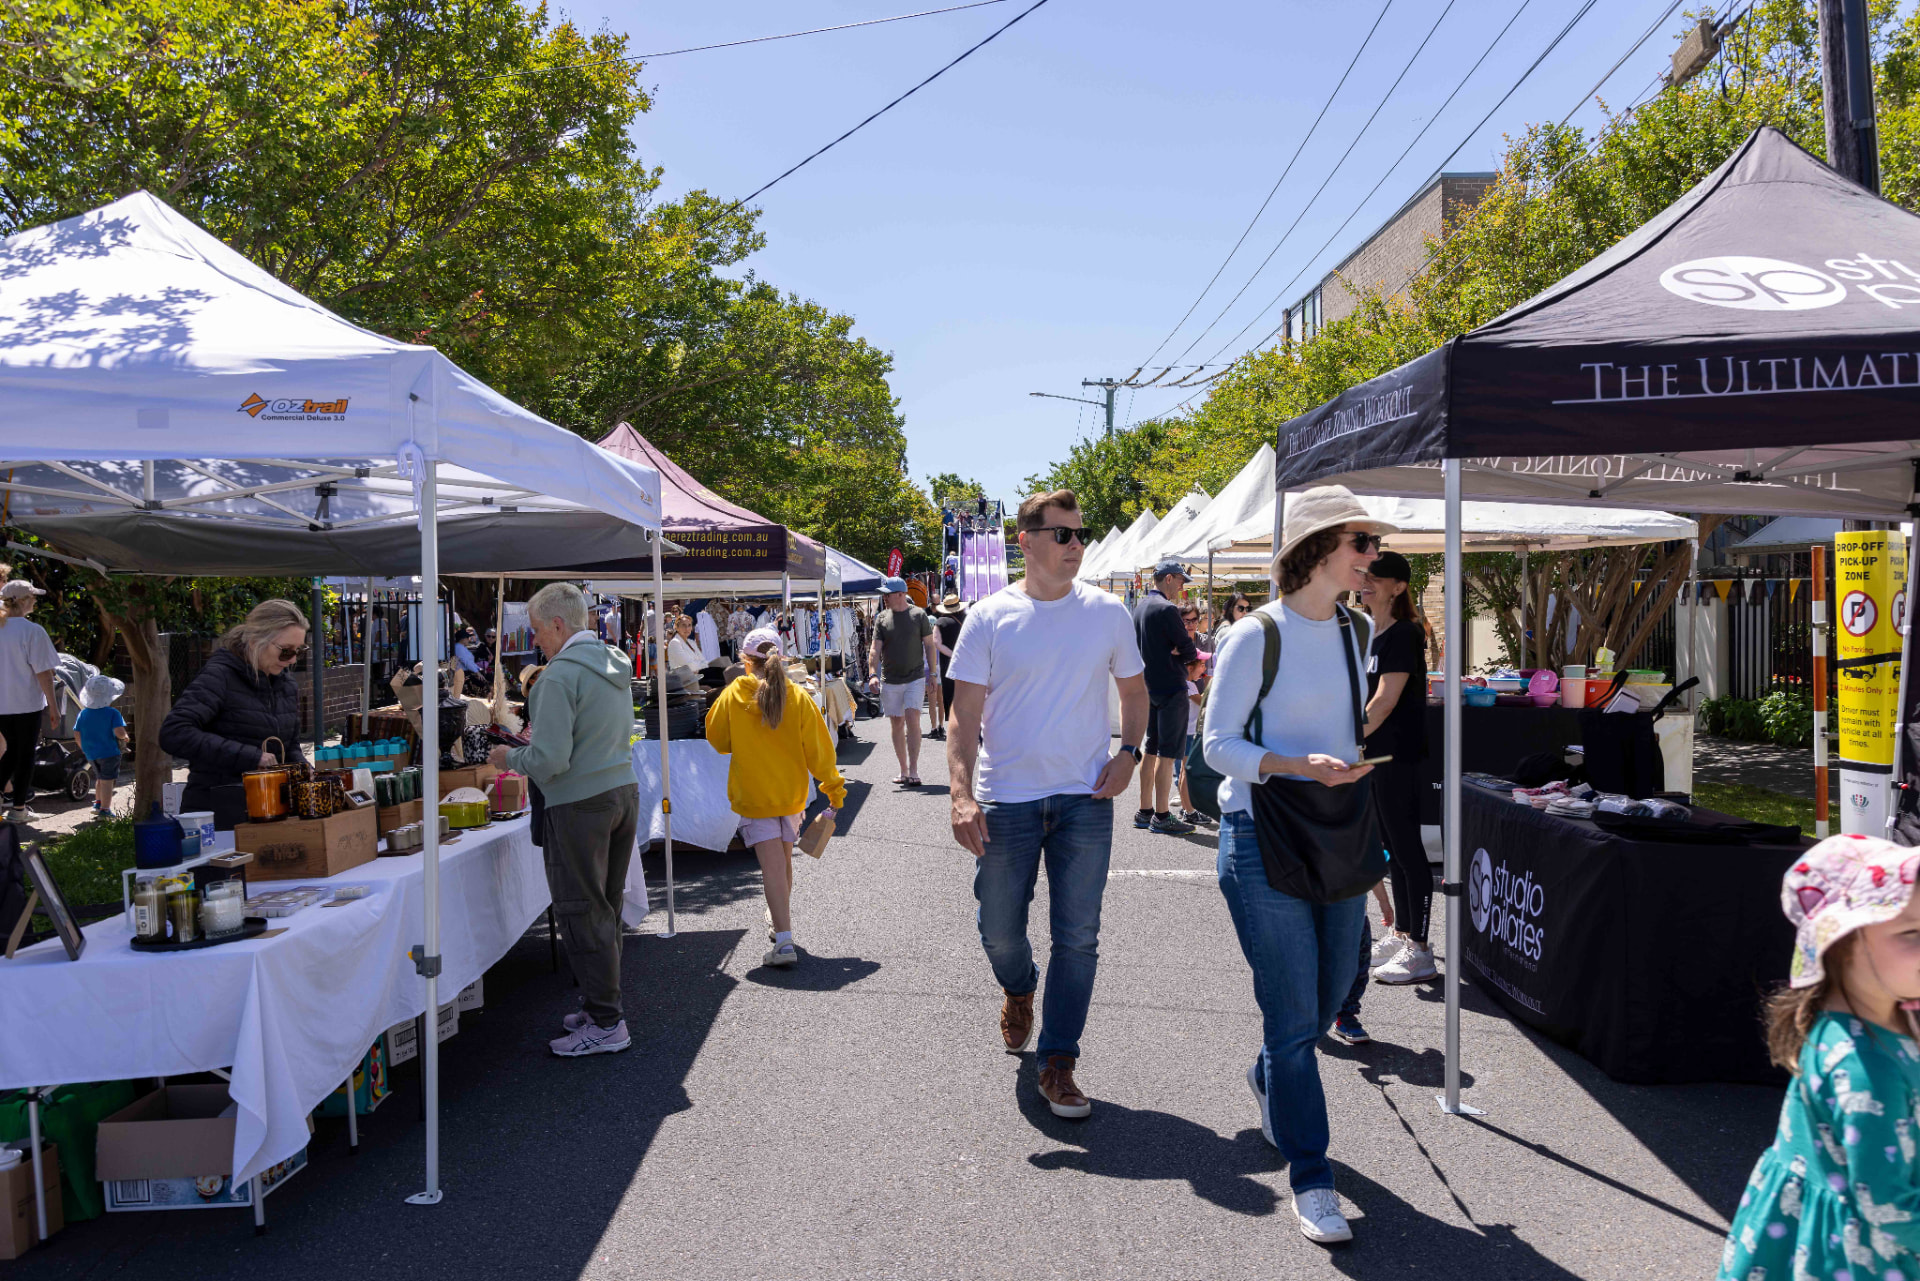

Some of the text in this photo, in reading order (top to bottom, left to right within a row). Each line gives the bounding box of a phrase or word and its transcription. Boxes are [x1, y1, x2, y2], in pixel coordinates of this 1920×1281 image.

[1580, 352, 1920, 400] THE ULTIMAT
[1364, 385, 1413, 426] WORKOUT
[1836, 541, 1885, 552] DROP-OFF
[664, 546, 768, 559] ztrading.com.au
[1840, 556, 1878, 566] PICK-UP
[1845, 571, 1870, 580] ZONE
[1842, 645, 1874, 656] No Parking
[1844, 685, 1864, 693] Minutes
[1866, 686, 1883, 695] Only
[1841, 705, 1880, 717] Driver must
[1841, 717, 1862, 725] remain
[1864, 719, 1881, 727] with
[1841, 727, 1861, 736] vehicle
[1872, 730, 1882, 738] all
[1493, 859, 1544, 917] studio
[1490, 899, 1544, 960] pilates
